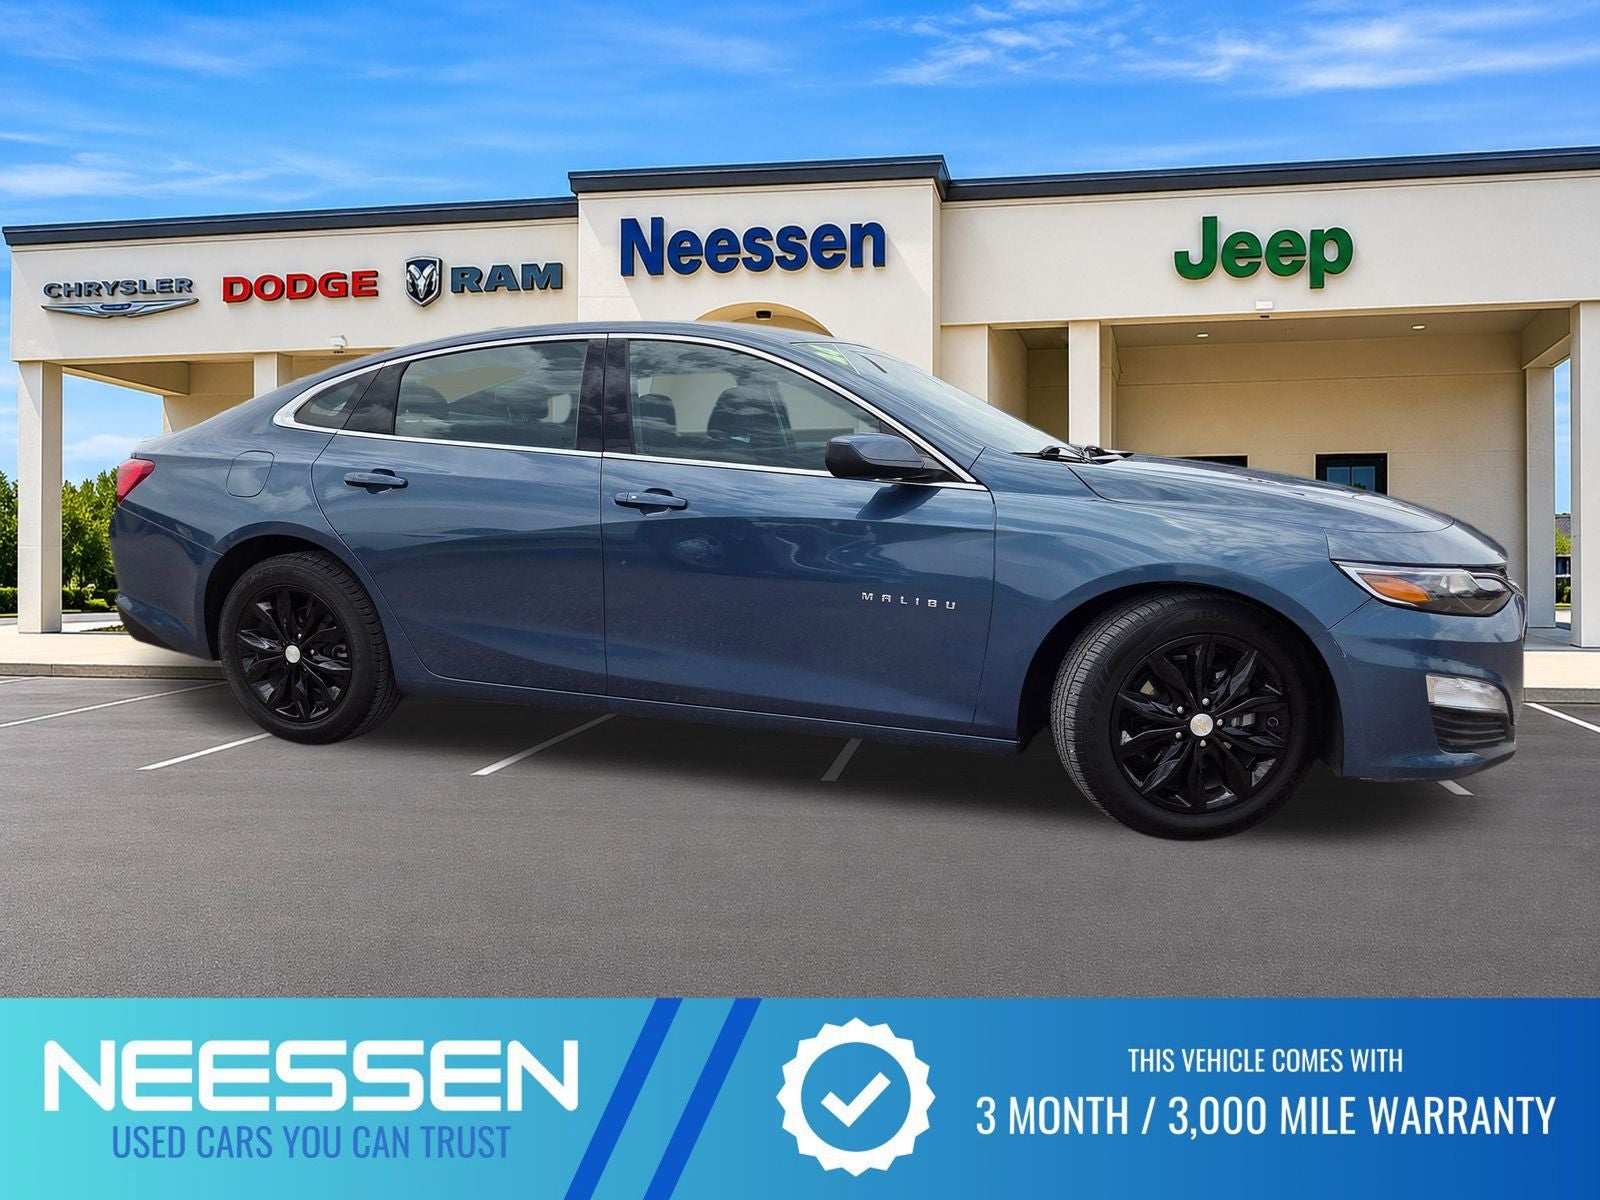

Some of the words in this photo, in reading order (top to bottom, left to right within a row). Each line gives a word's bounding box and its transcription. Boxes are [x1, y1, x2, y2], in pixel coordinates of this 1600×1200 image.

[620, 216, 886, 276] Neessen
[1174, 216, 1354, 288] Jeep
[43, 278, 194, 299] CHRYSLER
[222, 270, 379, 303] DODGE
[451, 262, 563, 294] RAM
[861, 592, 956, 610] MALIBU
